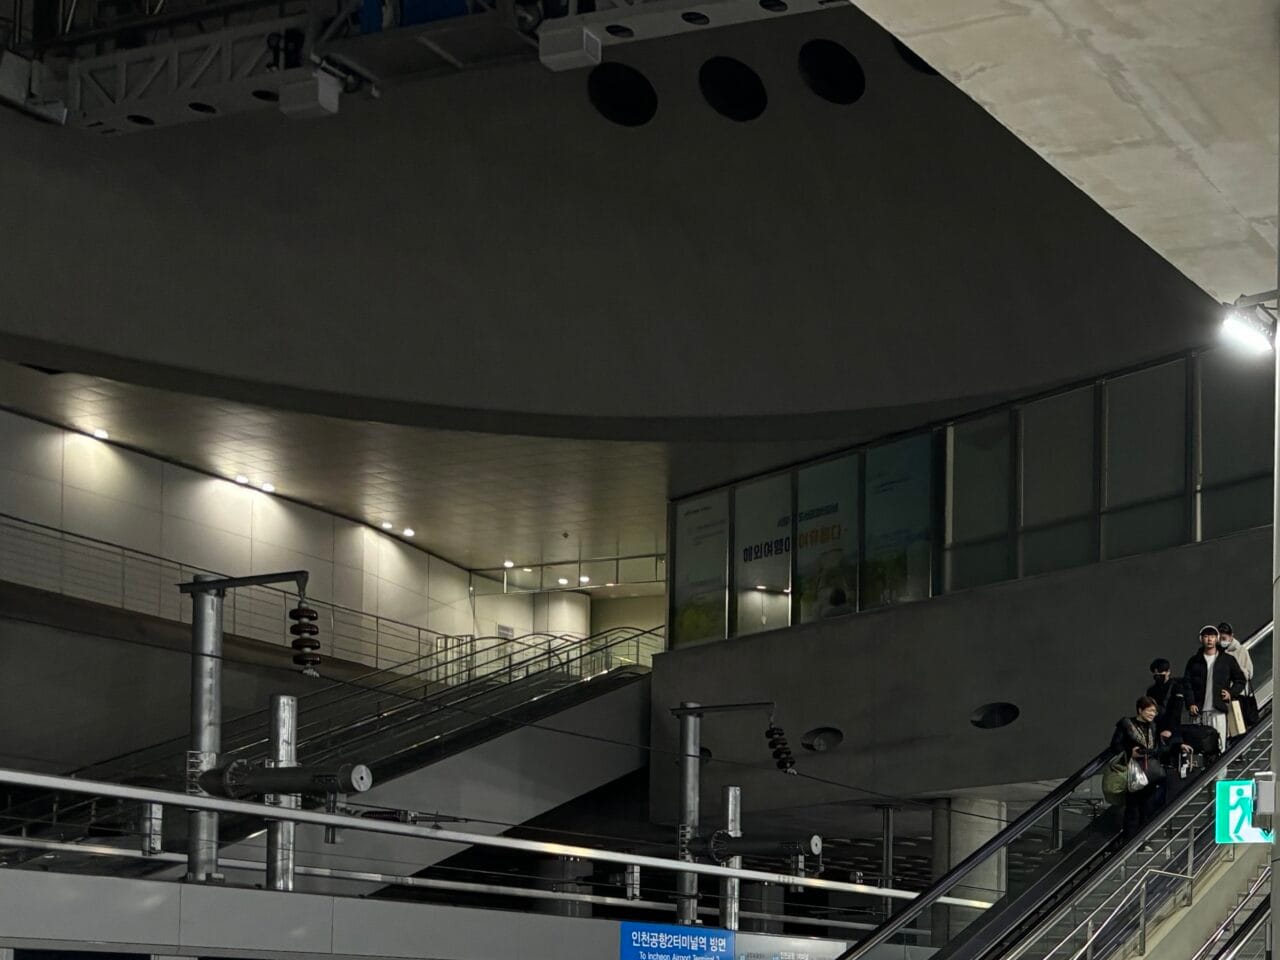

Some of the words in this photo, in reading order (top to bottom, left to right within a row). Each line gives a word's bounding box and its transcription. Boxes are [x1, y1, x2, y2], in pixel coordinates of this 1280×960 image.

[631, 930, 707, 951] 인천공항2터미널역
[709, 936, 726, 952] 방면
[640, 951, 647, 960] To
